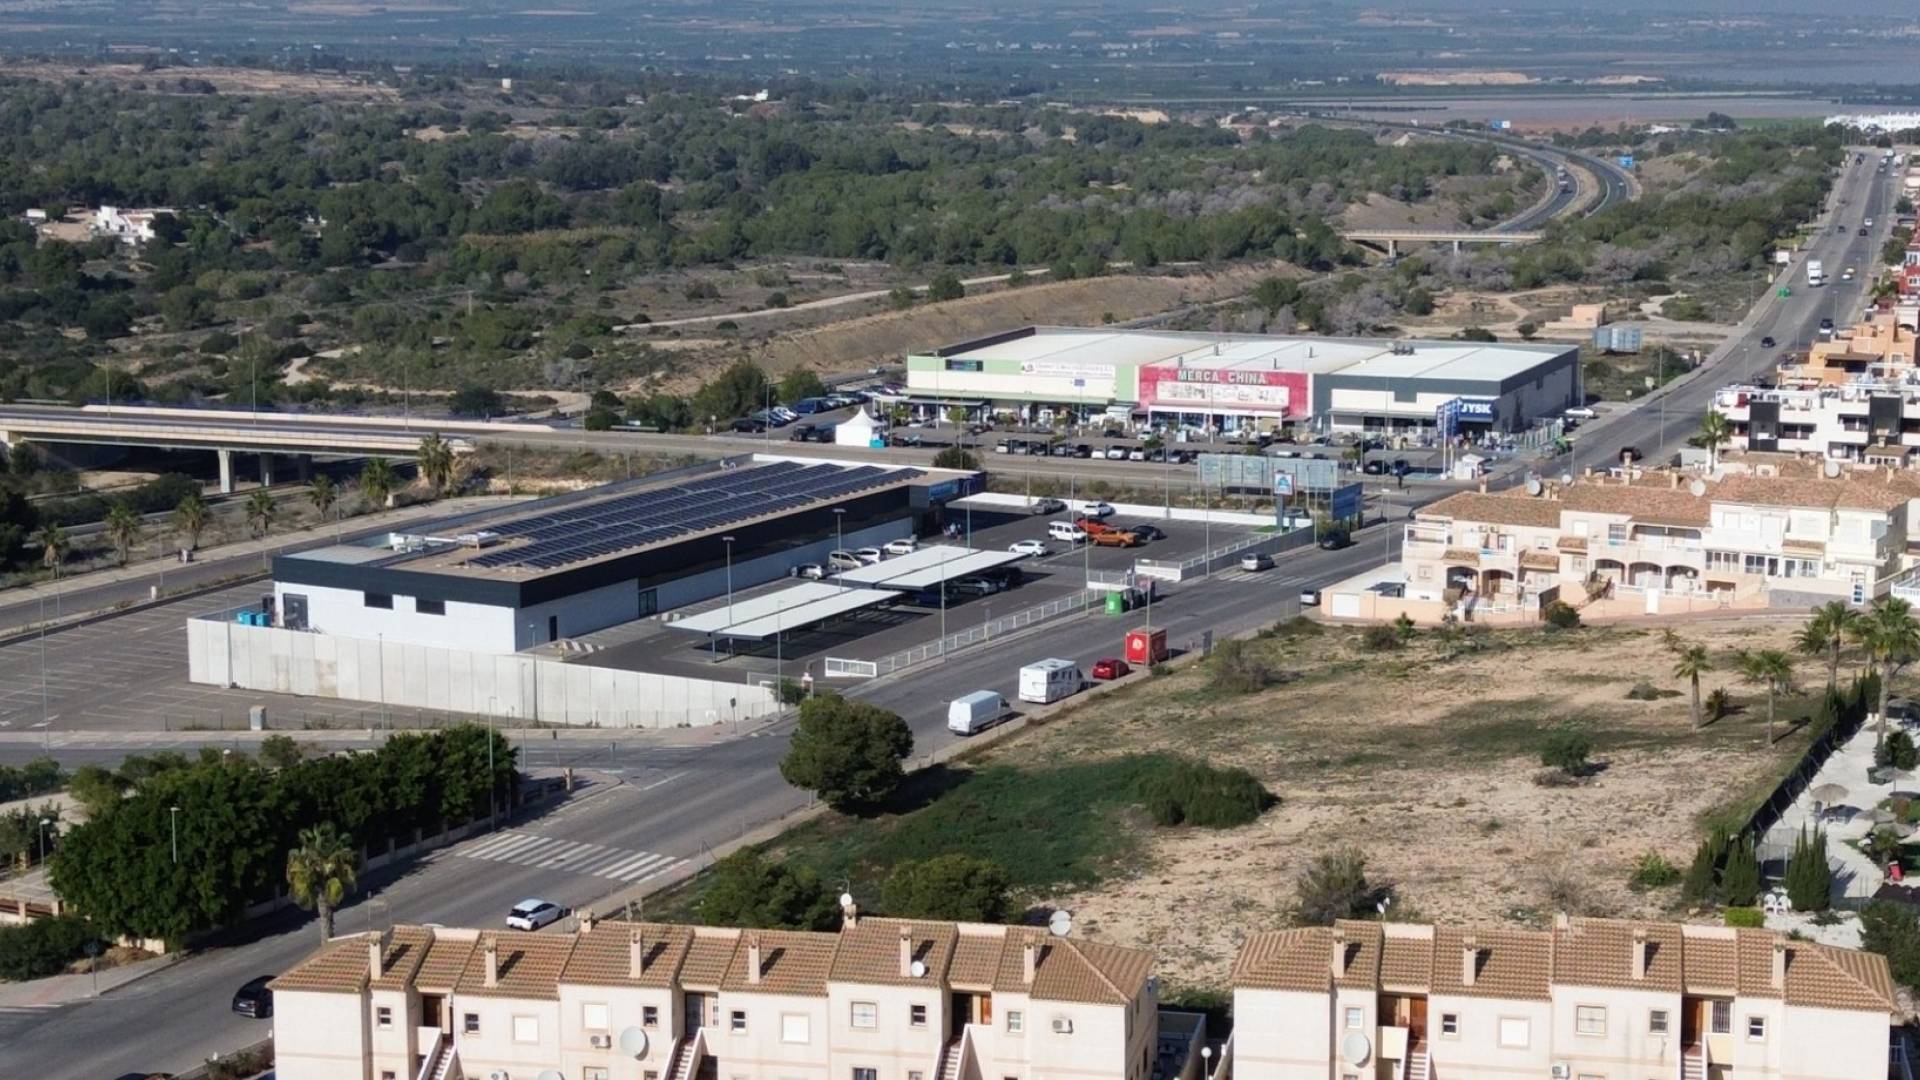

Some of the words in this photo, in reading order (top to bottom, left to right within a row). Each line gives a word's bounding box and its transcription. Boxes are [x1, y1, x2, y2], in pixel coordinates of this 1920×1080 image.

[1178, 369, 1219, 382] MERCA
[1228, 371, 1267, 384] CHINA
[1461, 403, 1492, 413] JYSK
